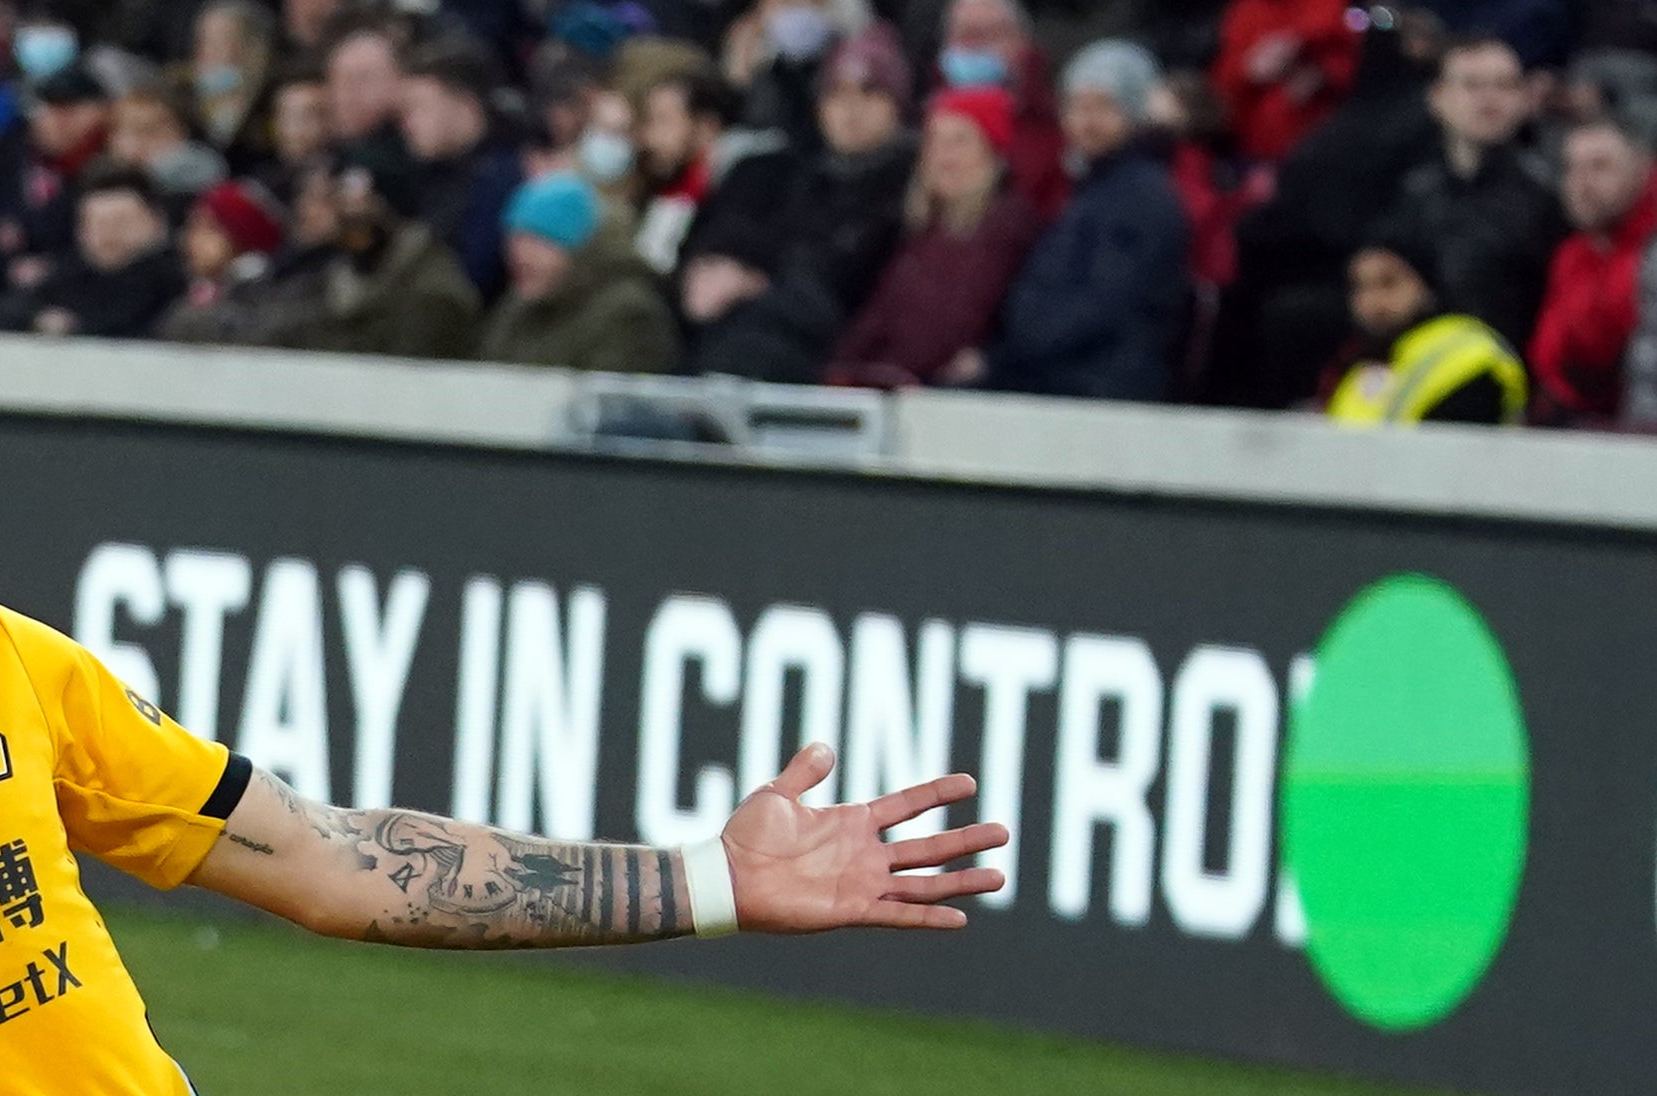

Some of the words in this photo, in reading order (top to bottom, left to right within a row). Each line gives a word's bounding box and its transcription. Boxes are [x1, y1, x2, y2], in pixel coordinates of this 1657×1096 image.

[74, 541, 431, 811] STAY
[453, 576, 607, 844] IN
[635, 592, 1318, 948] CONTRO
